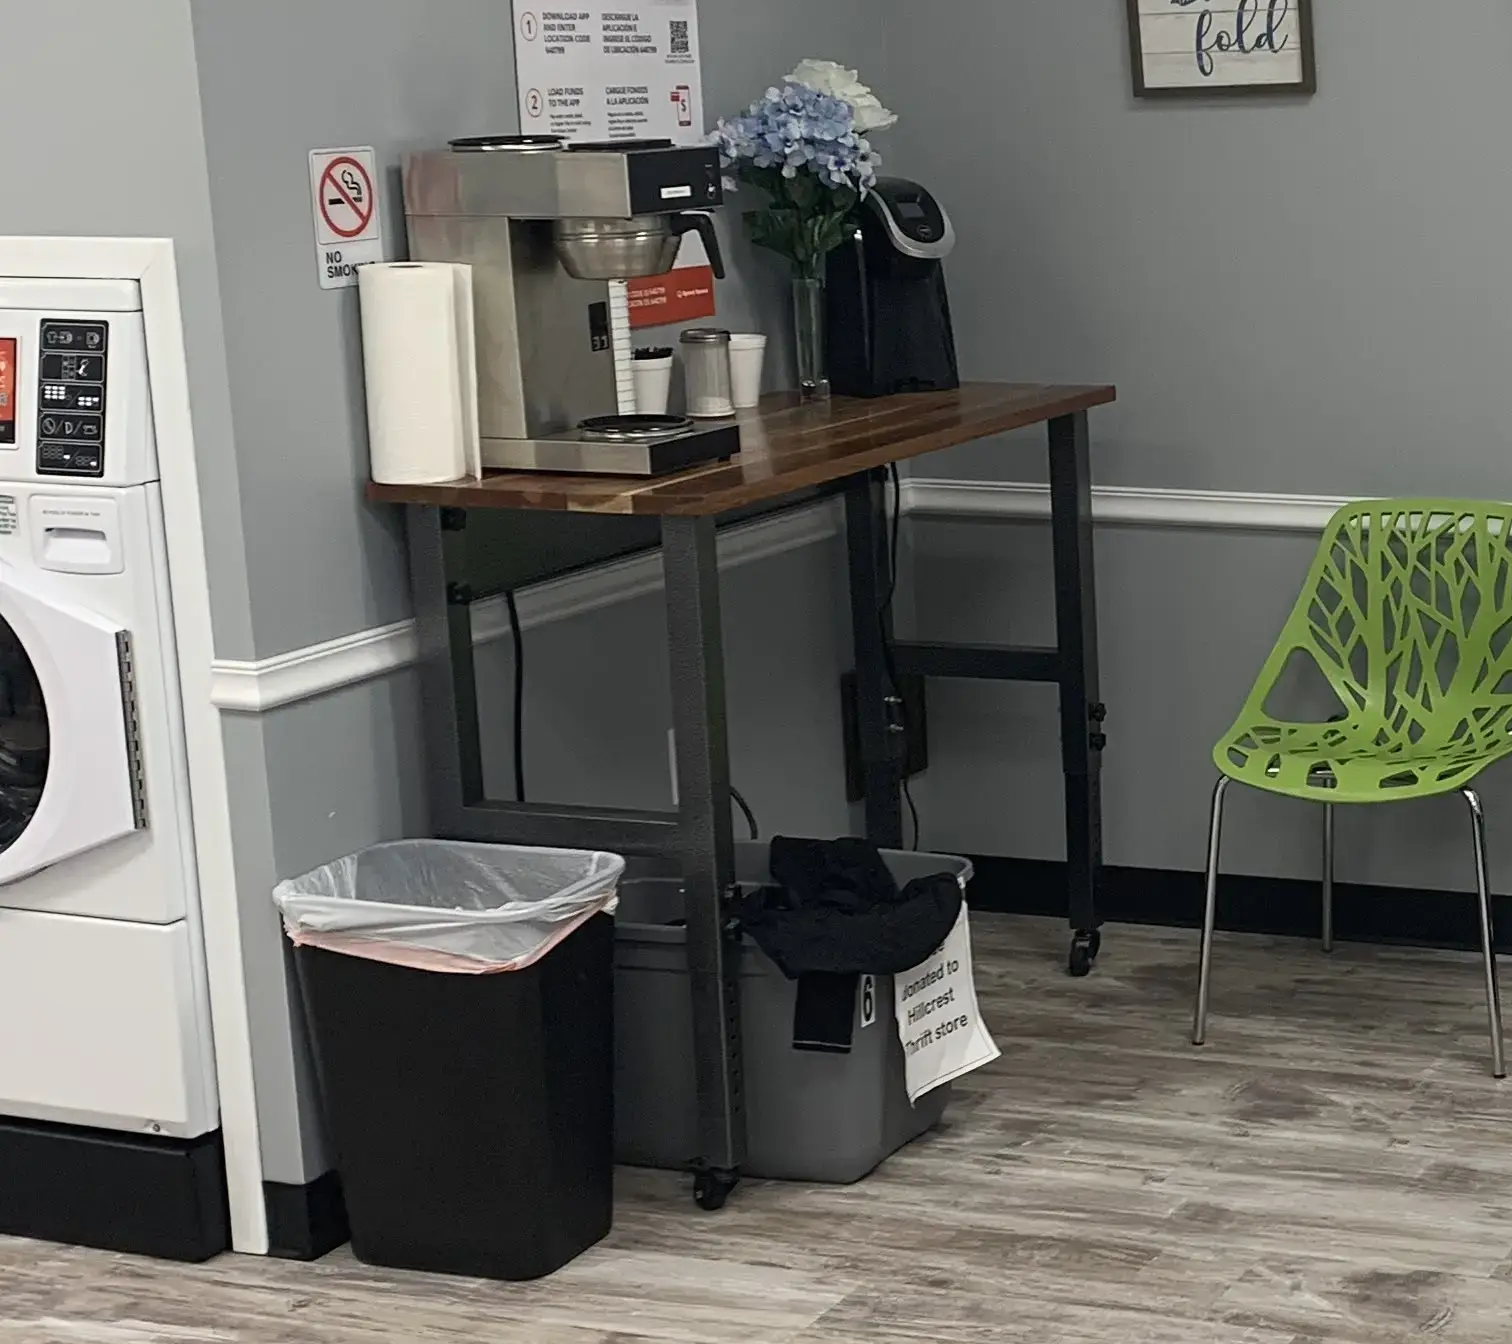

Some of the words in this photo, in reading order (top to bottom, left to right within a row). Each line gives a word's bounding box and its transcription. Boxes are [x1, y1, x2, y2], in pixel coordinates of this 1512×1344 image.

[542, 12, 577, 21] DOWNLOAD
[526, 20, 532, 34] 1
[544, 35, 574, 43] LOCATION
[575, 35, 591, 43] CODE
[548, 88, 563, 96] LOAD
[531, 95, 538, 110] 2
[325, 250, 342, 264] NO
[901, 965, 945, 1002] donated
[947, 958, 960, 976] to
[862, 975, 874, 1022] 6
[907, 986, 956, 1026] Hillcrest
[905, 1028, 934, 1057] Thrift
[934, 1013, 969, 1040] store
